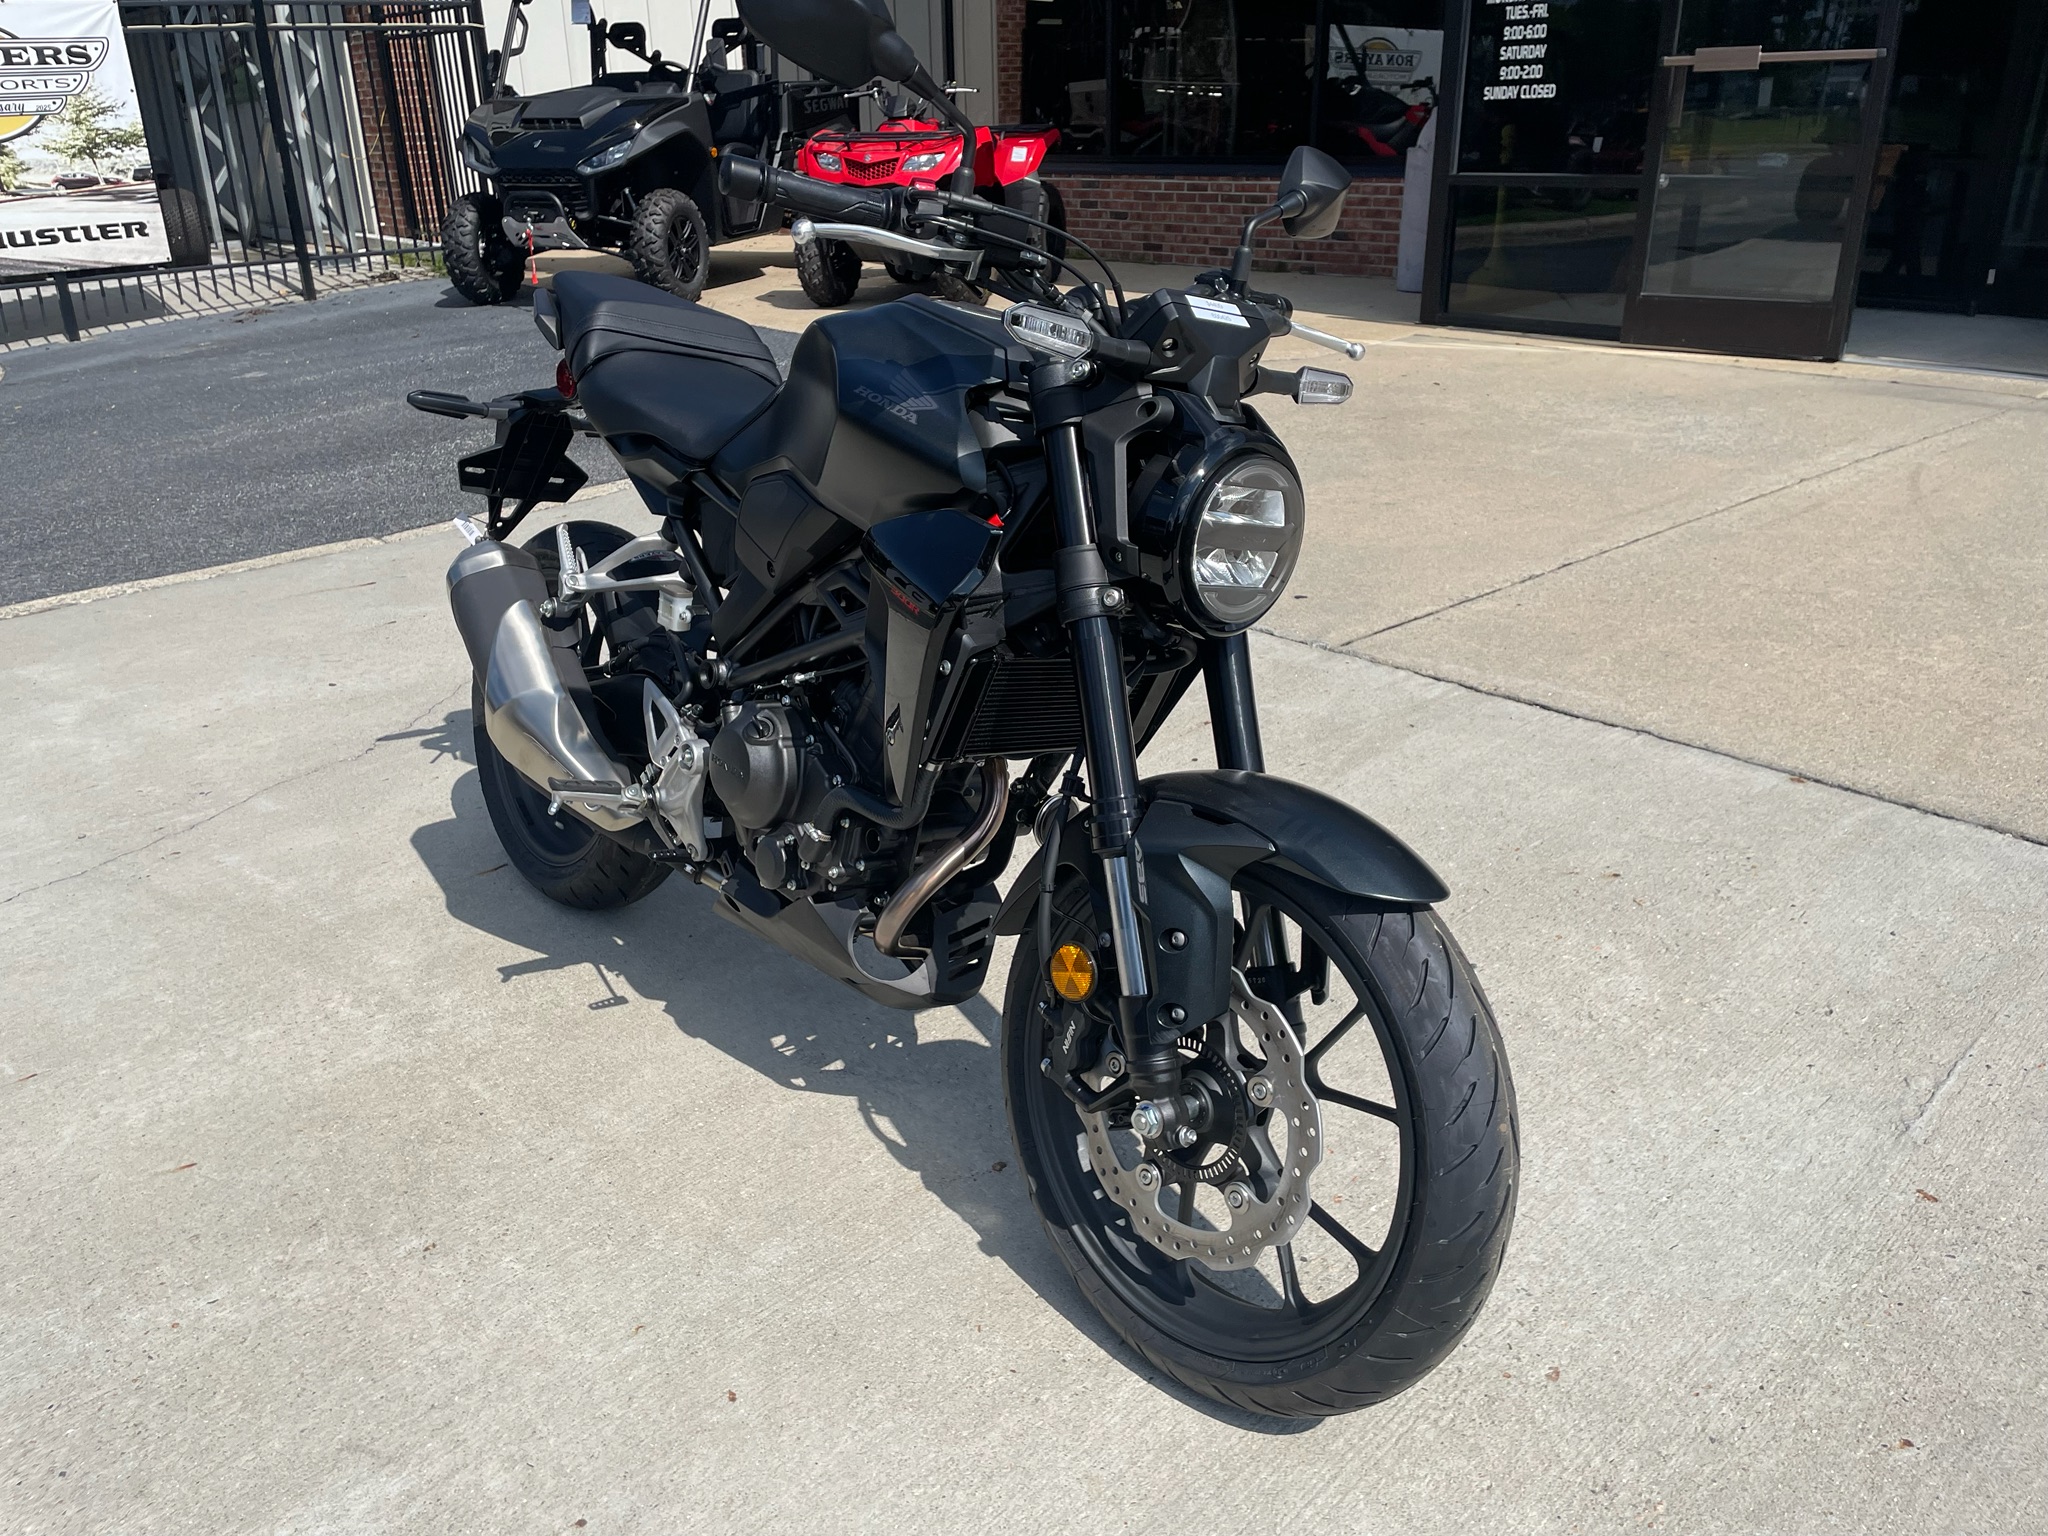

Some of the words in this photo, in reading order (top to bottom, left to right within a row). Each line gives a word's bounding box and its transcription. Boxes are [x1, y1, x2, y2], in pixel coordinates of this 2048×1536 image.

[1503, 23, 1548, 40] 9:00-6:00
[1499, 44, 1548, 60] SATURDAY
[1499, 64, 1544, 80] 9:00-2:00
[1483, 85, 1520, 100] SUNDAY
[1520, 83, 1557, 99] CLOSED
[803, 96, 849, 114] SEGWAY
[853, 385, 918, 425] HONDA
